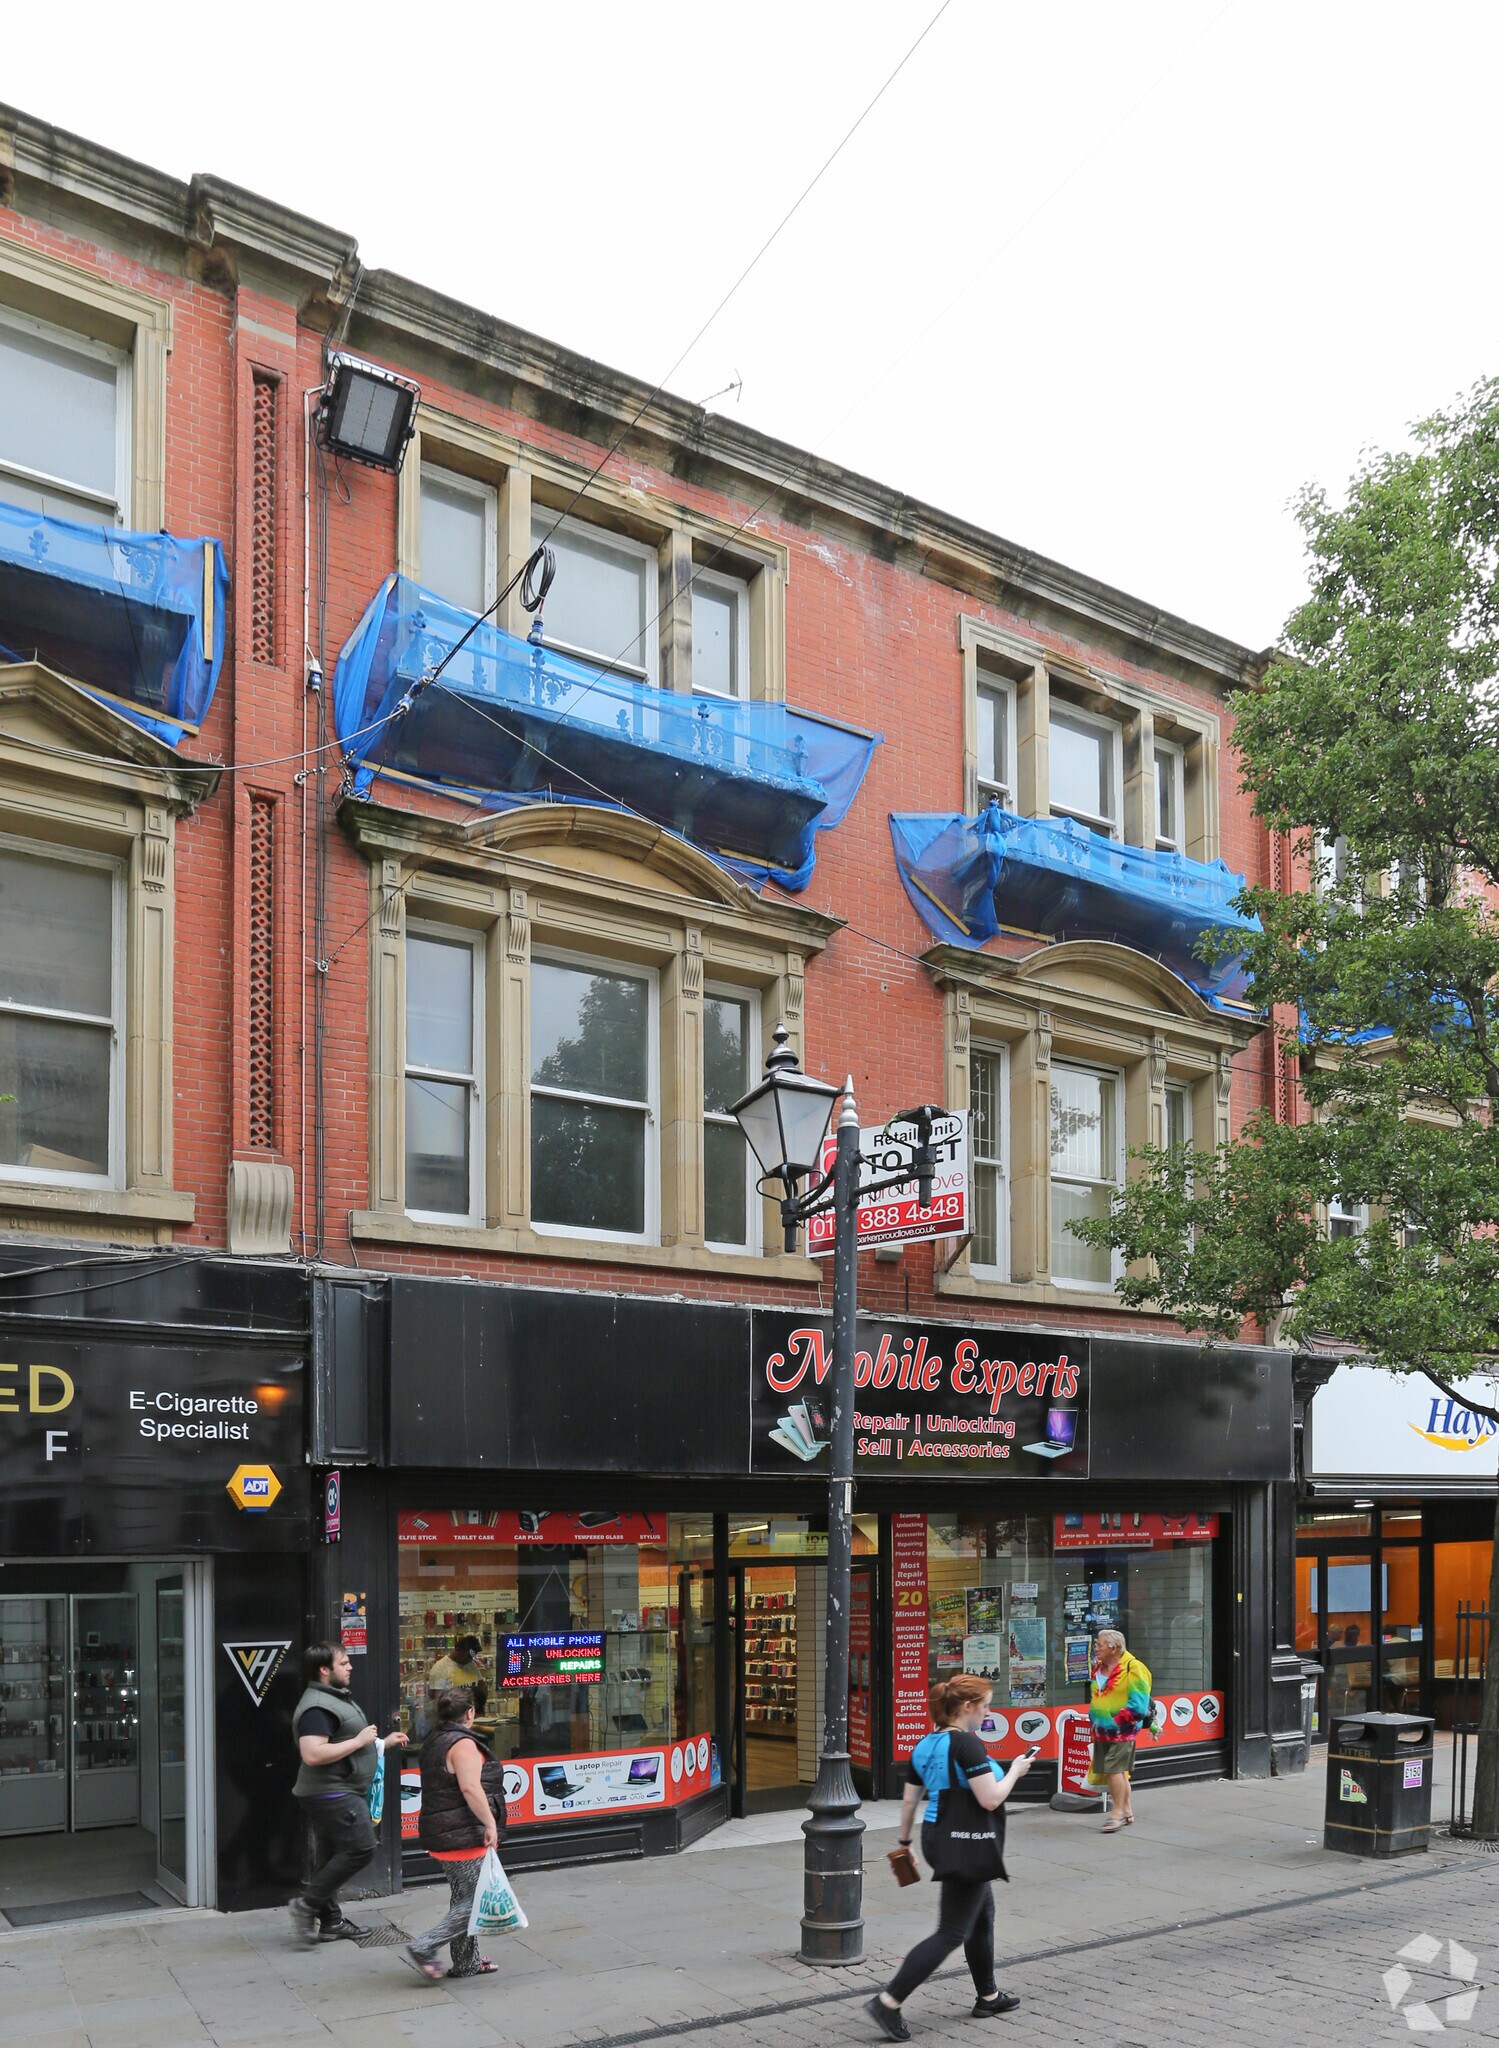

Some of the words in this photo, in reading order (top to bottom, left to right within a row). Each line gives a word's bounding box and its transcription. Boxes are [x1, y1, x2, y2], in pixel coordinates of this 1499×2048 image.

[873, 1127, 917, 1147] Retail
[867, 1150, 903, 1175] TO
[935, 1138, 962, 1163] ET
[860, 1207, 899, 1230] 388
[905, 1196, 960, 1222] 4848
[766, 1328, 943, 1394] Mobile
[950, 1338, 1080, 1415] Experts
[129, 1390, 258, 1416] E-Cigarette
[853, 1411, 909, 1435] Repair
[926, 1414, 1016, 1439] Unlocking
[1426, 1398, 1497, 1445] Hays
[139, 1418, 250, 1441] Specialist
[46, 1430, 69, 1462] F
[857, 1437, 891, 1456] Sell
[908, 1438, 1010, 1458] Accessories
[243, 1479, 268, 1494] ADT
[897, 1571, 923, 1579] Repair
[898, 1590, 923, 1606] 20
[506, 1638, 525, 1648] ALL
[528, 1636, 565, 1647] MOBILE
[568, 1635, 602, 1645] PHONE
[545, 1648, 601, 1658] UNLOCKING
[559, 1660, 602, 1671] REPAIRS
[502, 1675, 571, 1687] ACCESSORIES
[575, 1673, 601, 1683] HERE
[900, 1704, 922, 1712] price
[897, 1722, 925, 1730] Mobile
[1075, 1726, 1091, 1735] MOBILE
[897, 1744, 915, 1752] Rep
[1067, 1748, 1090, 1756] Unlocki
[1339, 1747, 1371, 1757] LITTER
[574, 1762, 601, 1771] Laptop
[601, 1760, 623, 1769] Repair
[1067, 1756, 1091, 1765] Repairin
[1064, 1765, 1088, 1775] Accesso
[1405, 1767, 1421, 1778] £150
[505, 1803, 520, 1811] ead
[950, 1831, 970, 1839] RIVER
